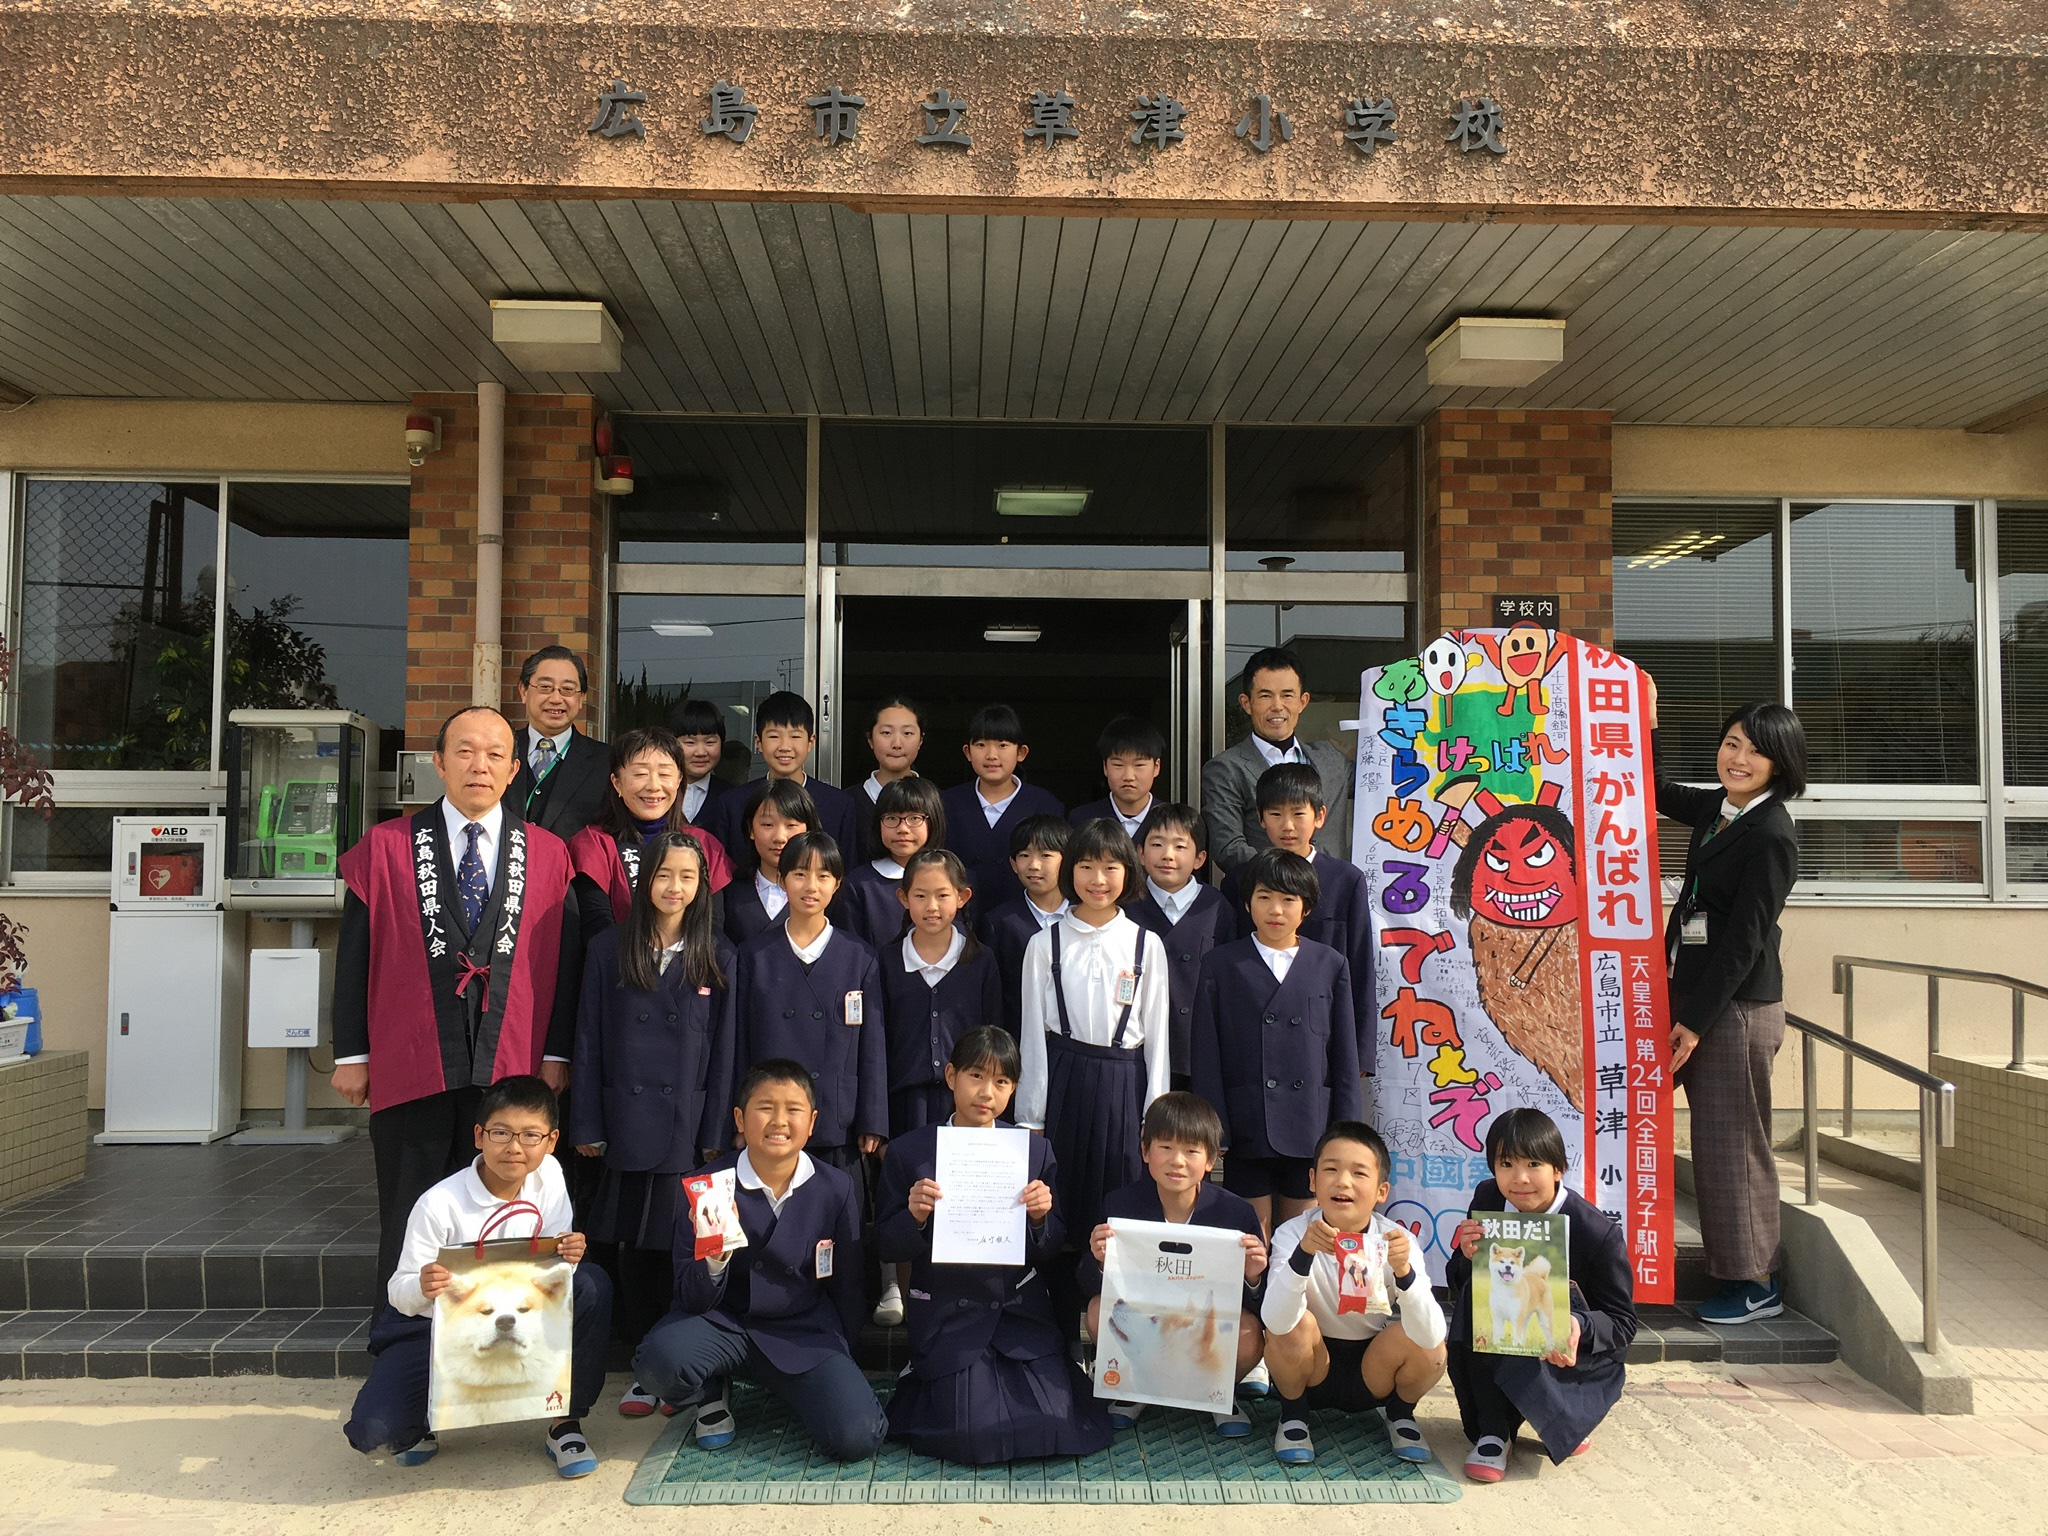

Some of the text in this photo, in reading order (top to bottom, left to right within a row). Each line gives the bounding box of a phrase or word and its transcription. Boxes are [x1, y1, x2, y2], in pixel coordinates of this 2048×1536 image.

[588, 81, 1508, 154] 広島市立草津小学校
[1500, 601, 1553, 617] 学校内
[162, 827, 188, 836] AED
[622, 848, 641, 888] 広島
[415, 828, 447, 958] 広島秋田県人会
[497, 829, 526, 955] 広島秋田県人会
[1482, 1218, 1550, 1241] 秋田だ!
[1154, 1256, 1192, 1276] 秋田
